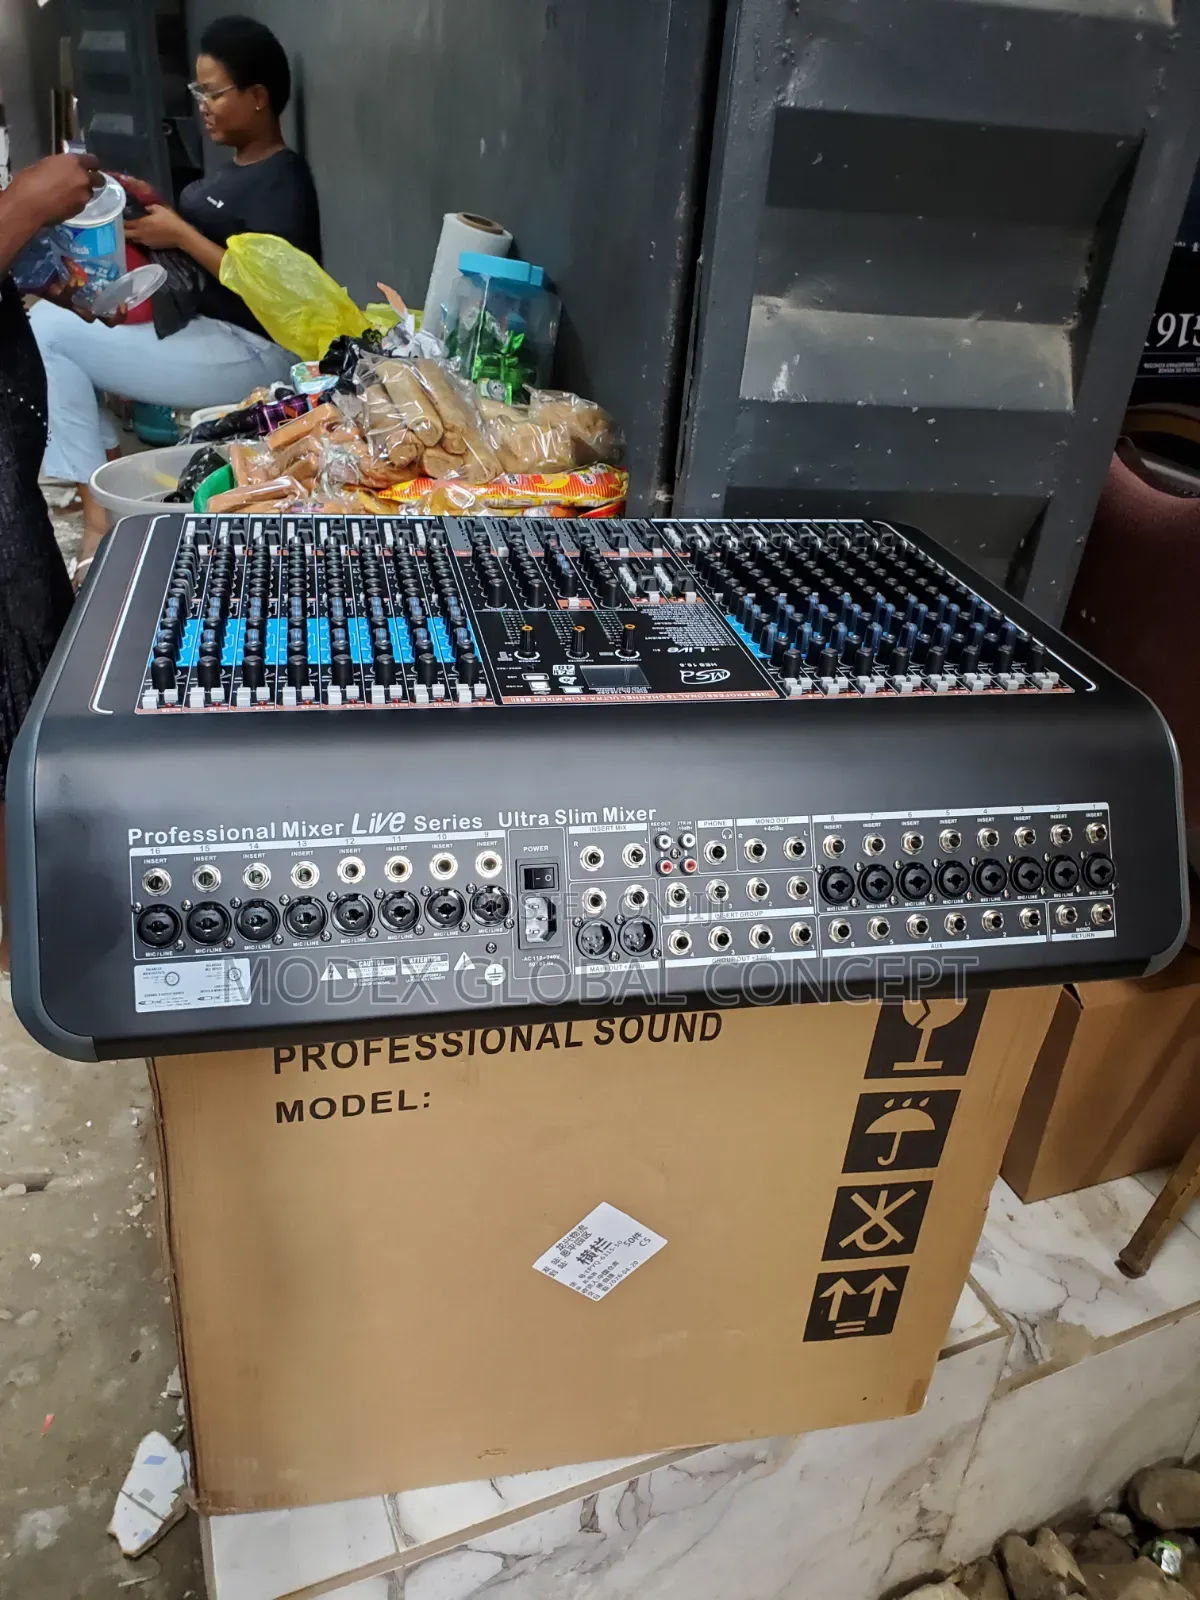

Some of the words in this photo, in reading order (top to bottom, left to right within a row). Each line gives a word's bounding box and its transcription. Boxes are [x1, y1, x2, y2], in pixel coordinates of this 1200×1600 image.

[128, 822, 276, 846] Professional
[282, 820, 344, 838] Mixer
[352, 811, 406, 834] Live
[414, 814, 482, 831] Series
[499, 812, 549, 828] Ultra
[554, 809, 598, 825] Slim
[603, 807, 657, 823] Mixer
[410, 956, 441, 964] ATTENTION
[272, 1021, 584, 1074] PROFESSIONAL
[593, 1011, 722, 1046] SOUND
[276, 1087, 431, 1124] MODEL:
[576, 1236, 613, 1266] 横栏
[624, 1232, 642, 1248] 50件
[639, 1238, 652, 1247] C5
